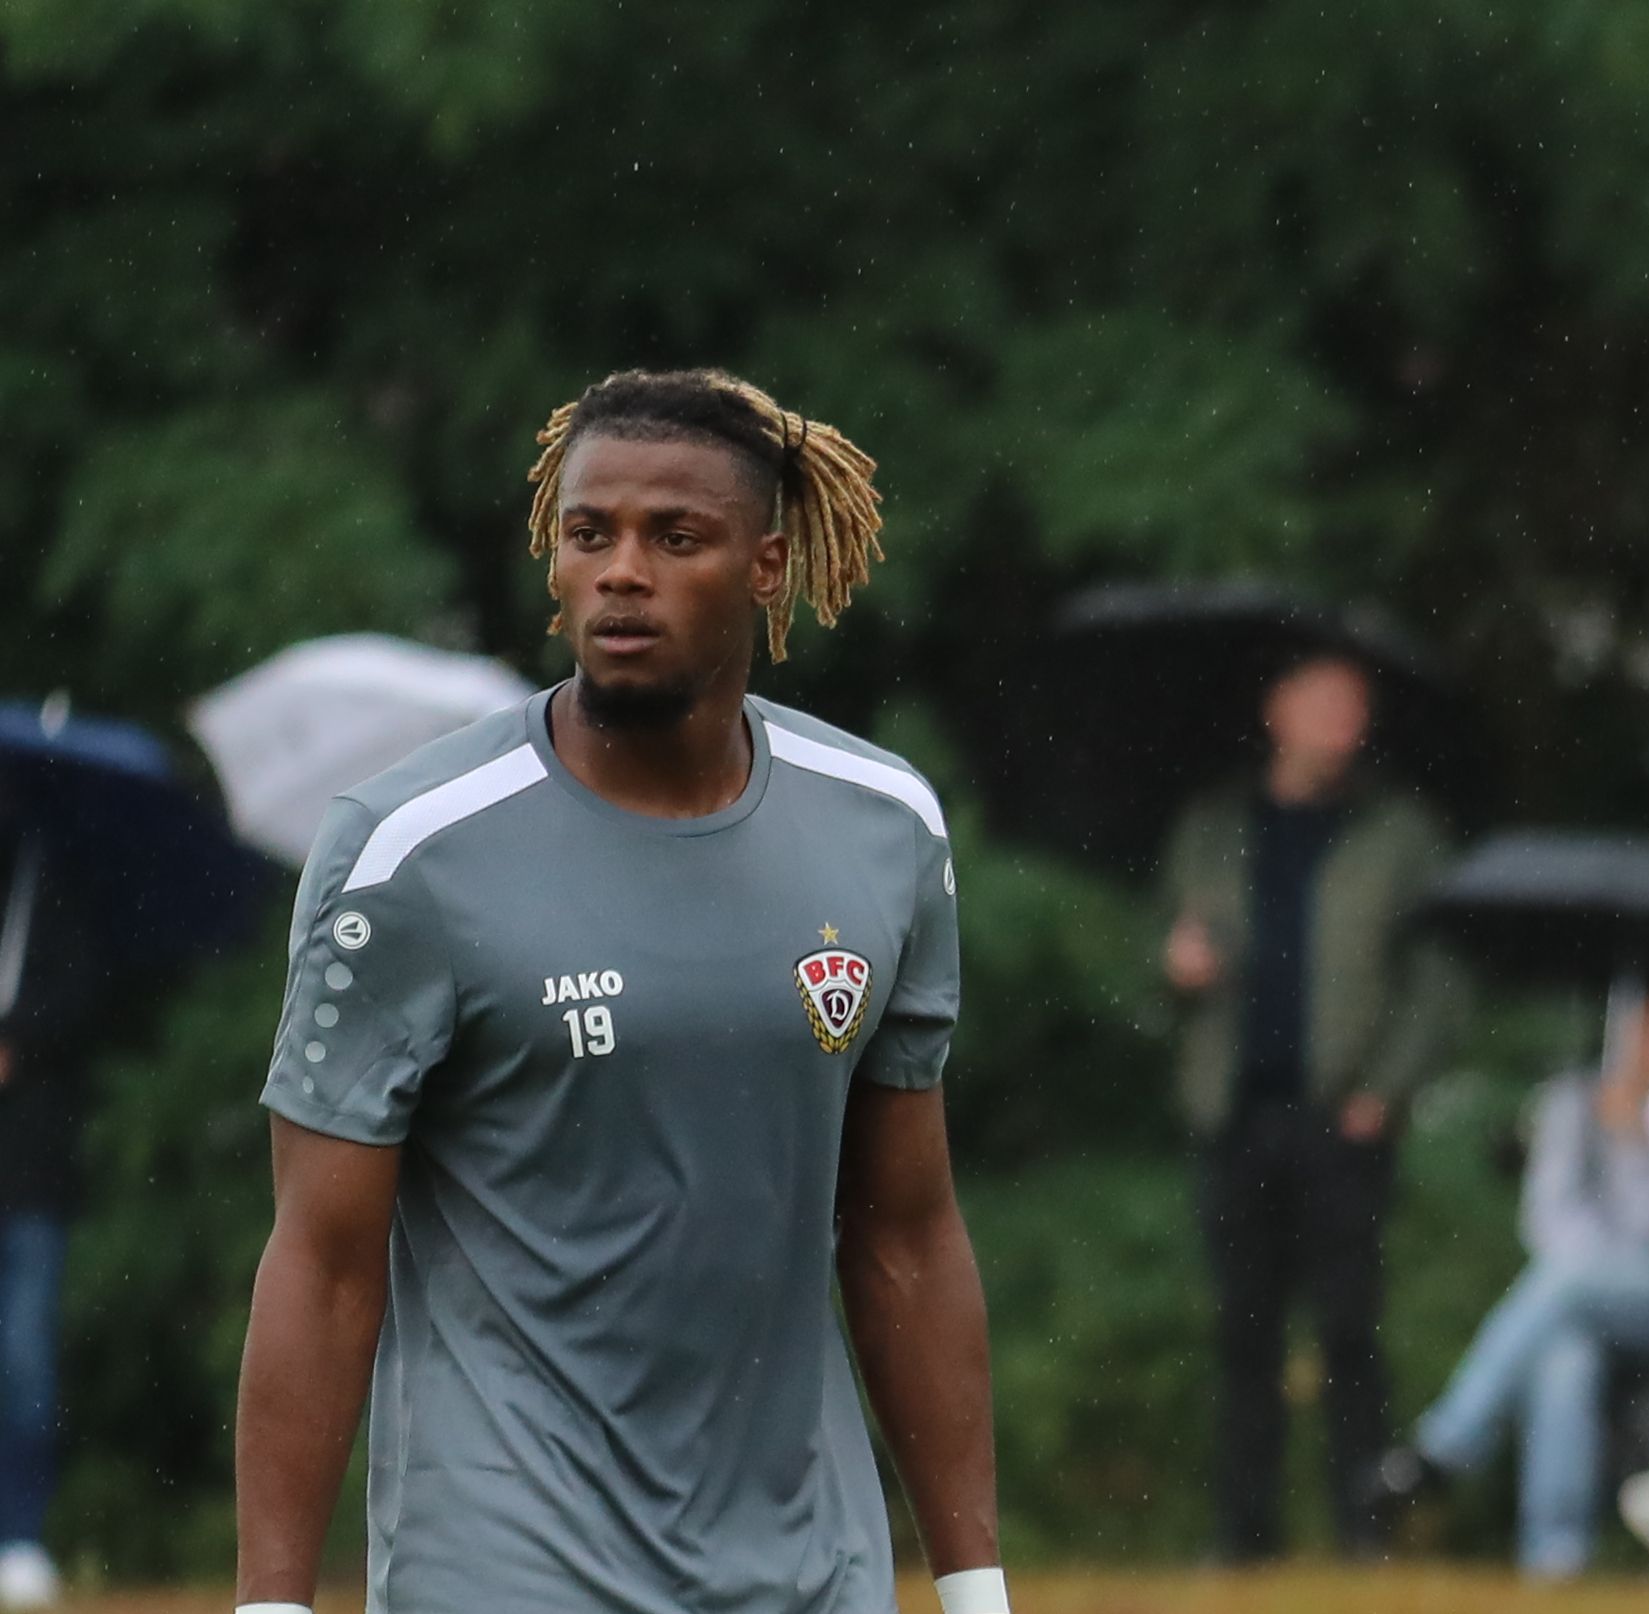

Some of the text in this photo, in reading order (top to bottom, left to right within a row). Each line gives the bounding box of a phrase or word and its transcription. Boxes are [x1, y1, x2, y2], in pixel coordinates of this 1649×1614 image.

[542, 969, 624, 1006] JAKO
[803, 956, 865, 987] BFC
[562, 1005, 616, 1058] 19
